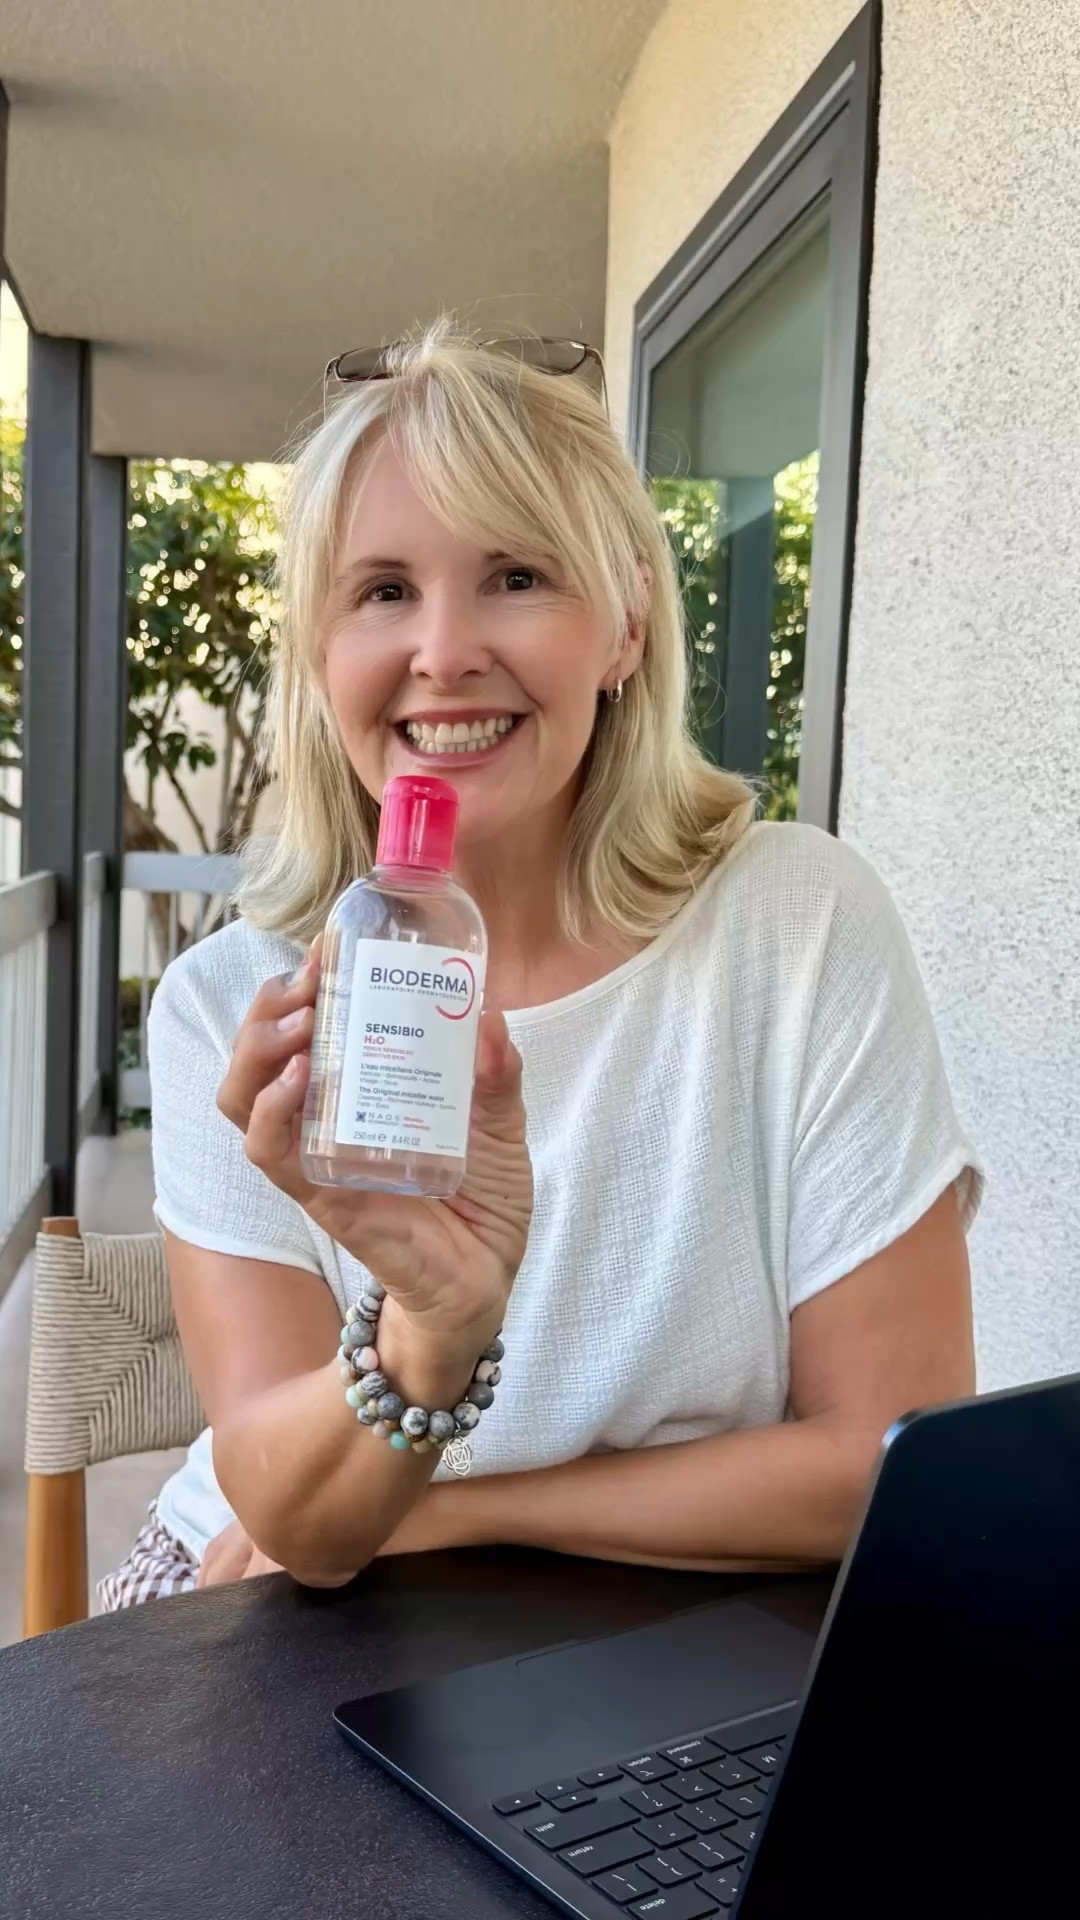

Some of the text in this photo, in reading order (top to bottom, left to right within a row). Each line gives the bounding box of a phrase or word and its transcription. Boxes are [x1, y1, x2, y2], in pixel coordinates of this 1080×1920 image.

[371, 967, 468, 995] BIODERMA
[365, 1023, 424, 1038] SENSIBIO
[380, 1065, 412, 1074] micellaire
[415, 1068, 442, 1077] Originale
[373, 1087, 400, 1097] Original
[401, 1091, 427, 1100] micellar
[353, 1131, 366, 1140] 250
[367, 1133, 376, 1141] ml
[667, 1740, 702, 1756] command
[628, 1756, 652, 1768] option
[762, 1754, 776, 1763] M
[535, 1822, 555, 1833] shift
[567, 1845, 595, 1858] return
[639, 1897, 666, 1911] delete
